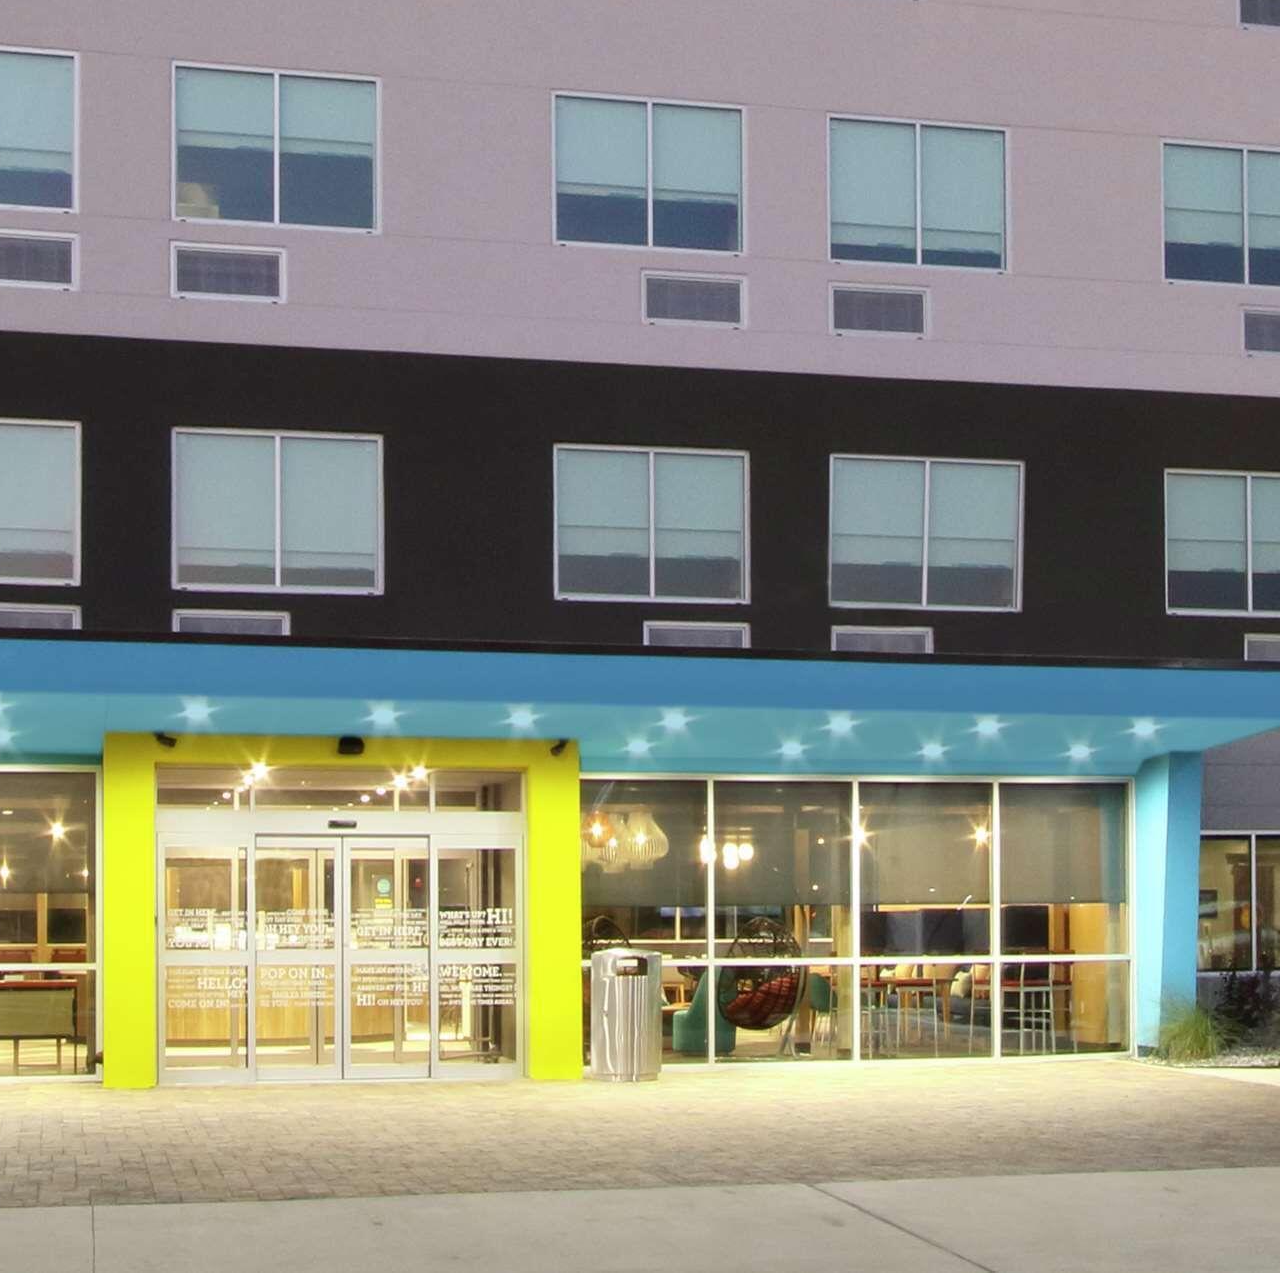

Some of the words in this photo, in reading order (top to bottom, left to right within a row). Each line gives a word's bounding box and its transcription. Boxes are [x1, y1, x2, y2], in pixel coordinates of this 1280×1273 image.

[487, 908, 513, 924] HI!
[260, 967, 287, 979] POP
[288, 967, 308, 979] ON
[357, 994, 376, 1006] HI!
